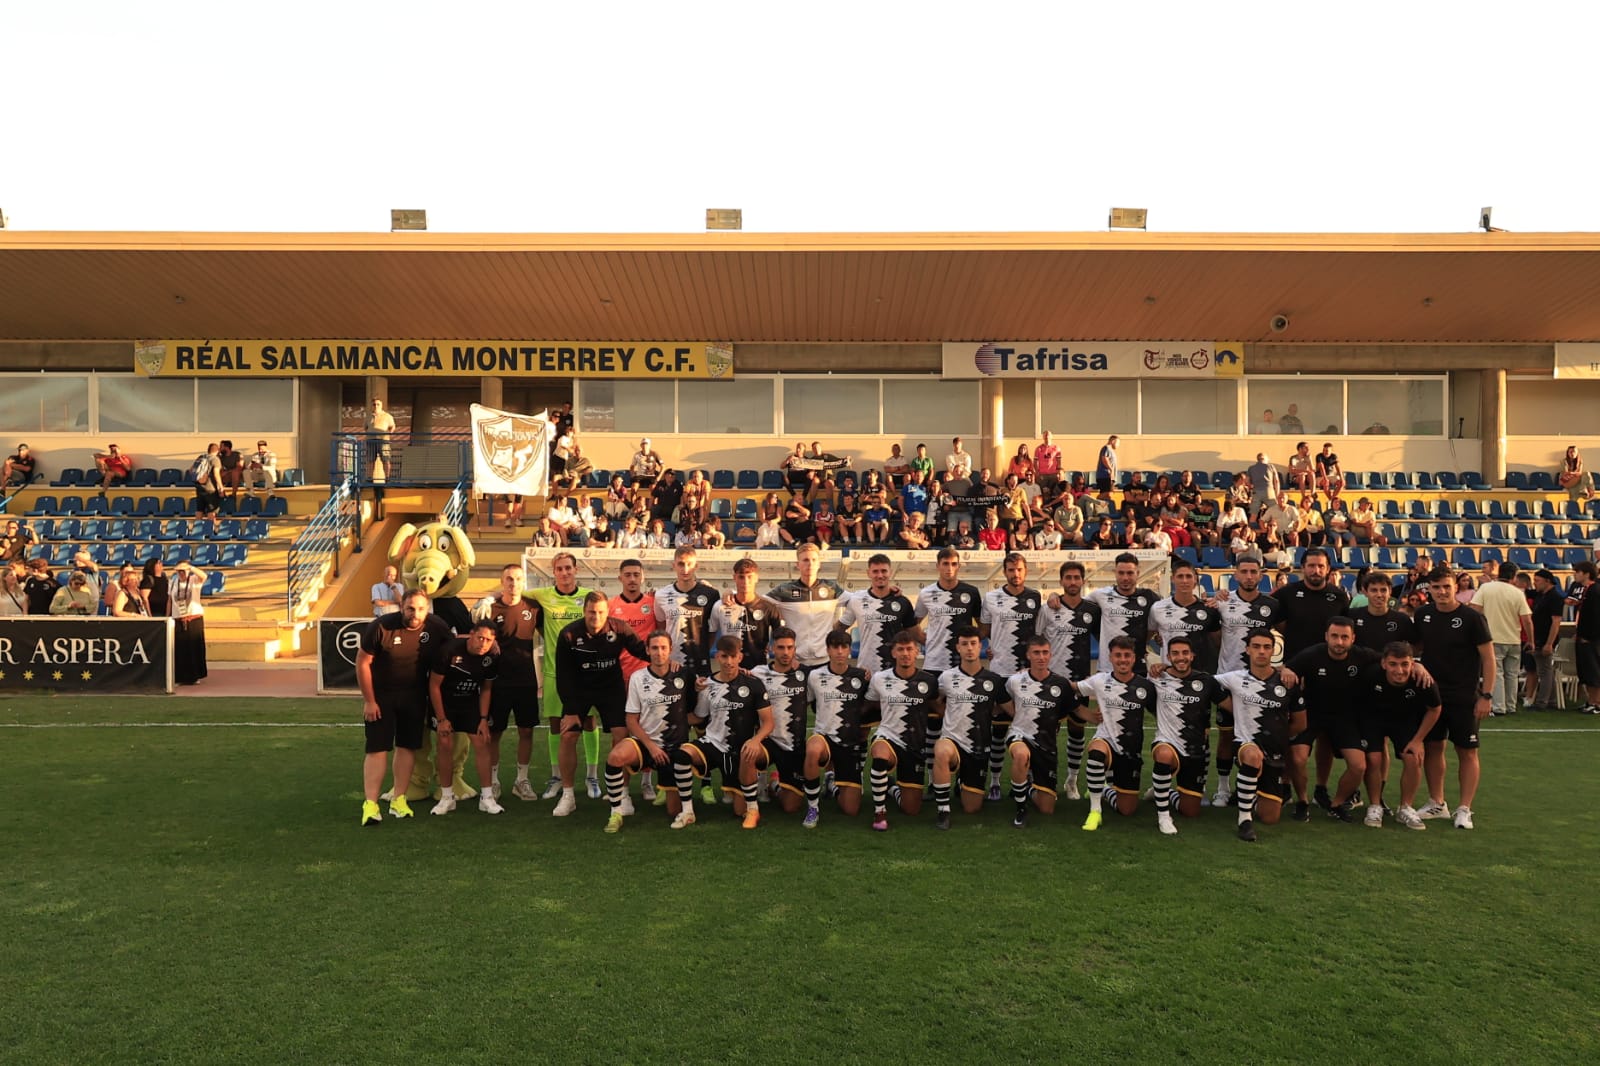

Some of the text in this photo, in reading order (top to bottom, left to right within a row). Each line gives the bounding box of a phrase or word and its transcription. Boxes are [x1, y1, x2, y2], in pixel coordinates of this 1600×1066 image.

[261, 345, 443, 371] SALAMANCA
[452, 346, 636, 371] MONTERREY
[645, 347, 695, 372] C.F.
[994, 347, 1108, 371] Tafrisa
[29, 637, 152, 665] ASPERA
